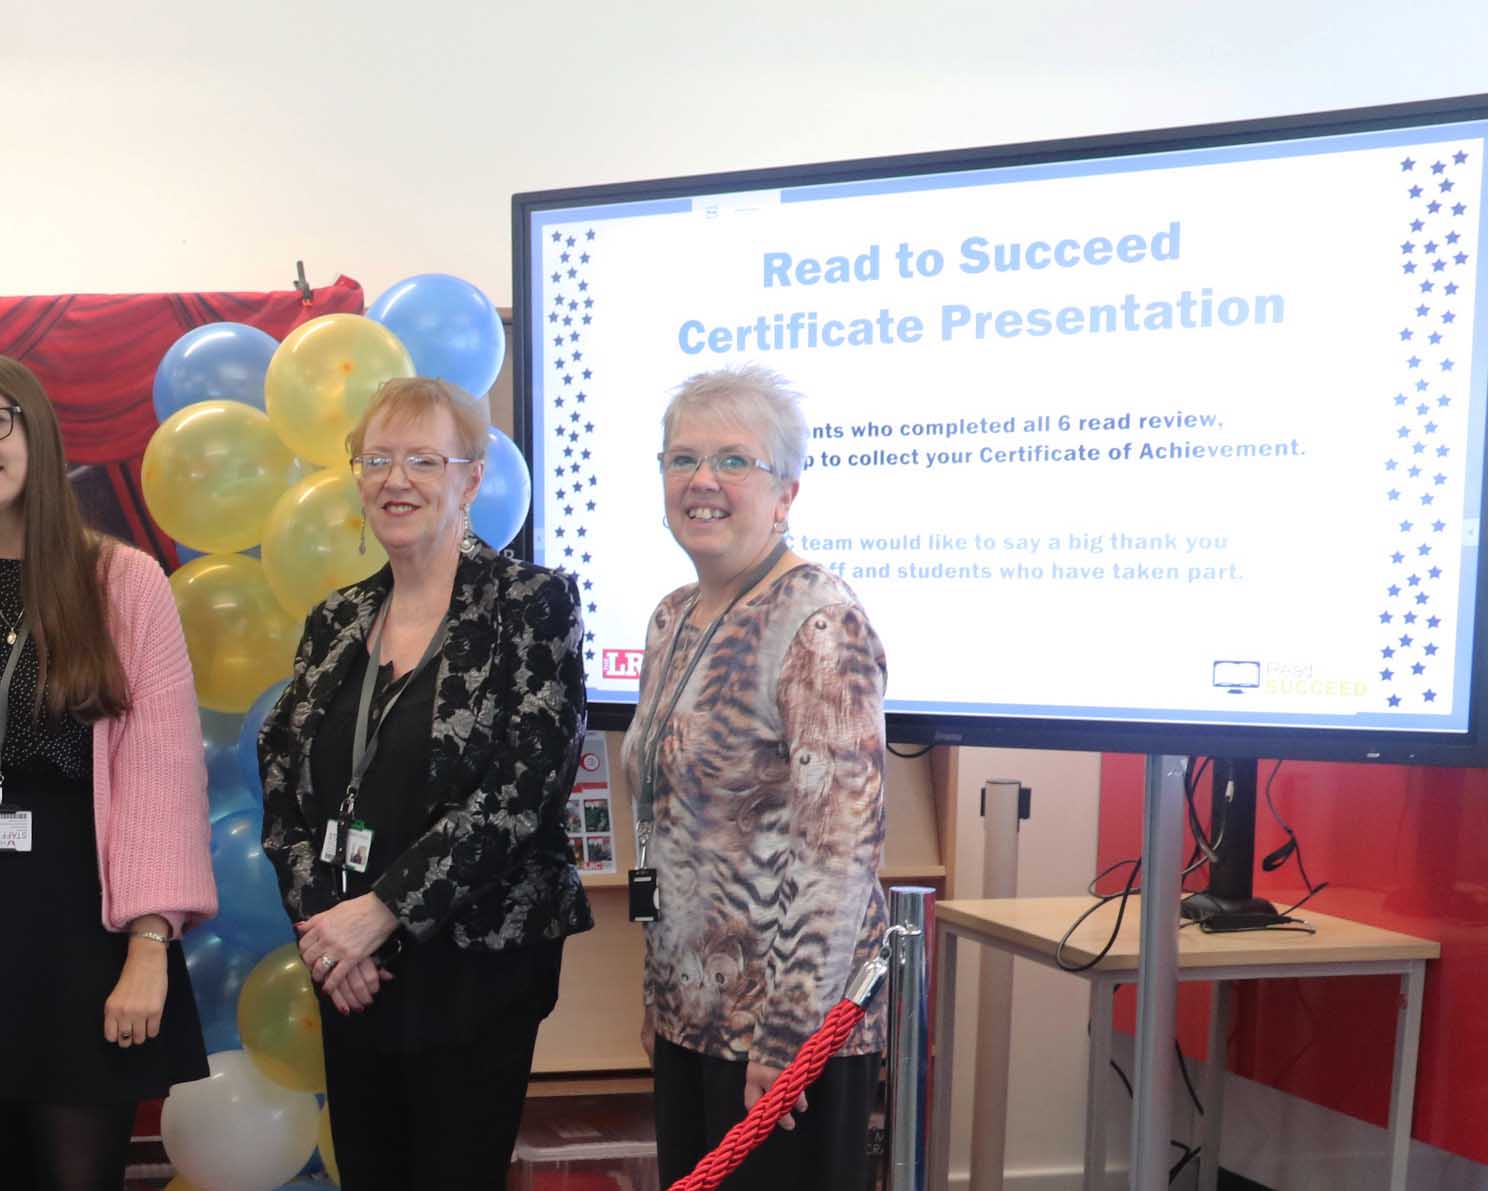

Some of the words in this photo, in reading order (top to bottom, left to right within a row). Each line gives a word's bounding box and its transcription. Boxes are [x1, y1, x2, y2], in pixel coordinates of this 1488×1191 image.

[763, 244, 880, 288] Read
[895, 242, 945, 279] to
[959, 221, 1181, 274] Succeed
[678, 309, 924, 355] Certificate
[941, 287, 1285, 341] Presentation
[808, 423, 845, 439] nts
[851, 421, 893, 438] who
[899, 416, 1016, 439] completed
[1023, 415, 1050, 433] all
[1058, 414, 1071, 432] 6
[1079, 412, 1131, 431] read
[803, 455, 815, 471] p
[820, 450, 842, 468] to
[847, 448, 919, 467] collect
[926, 451, 973, 469] your
[979, 444, 1101, 464] Certificate
[1107, 442, 1133, 461] of
[1138, 437, 1307, 461] Achievement.
[801, 535, 853, 552] team
[859, 534, 921, 551] would
[928, 533, 968, 551] like
[974, 533, 997, 551] to
[1003, 535, 1041, 554] say
[1048, 536, 1061, 551] a
[1068, 532, 1105, 554] big
[1109, 531, 1178, 551] thank
[1185, 535, 1229, 554] you
[852, 562, 891, 579] and
[897, 561, 992, 580] students
[999, 561, 1045, 581] who
[1051, 561, 1105, 581] have
[1112, 561, 1180, 581] taken
[1188, 562, 1245, 584] part.
[607, 652, 644, 676] LR
